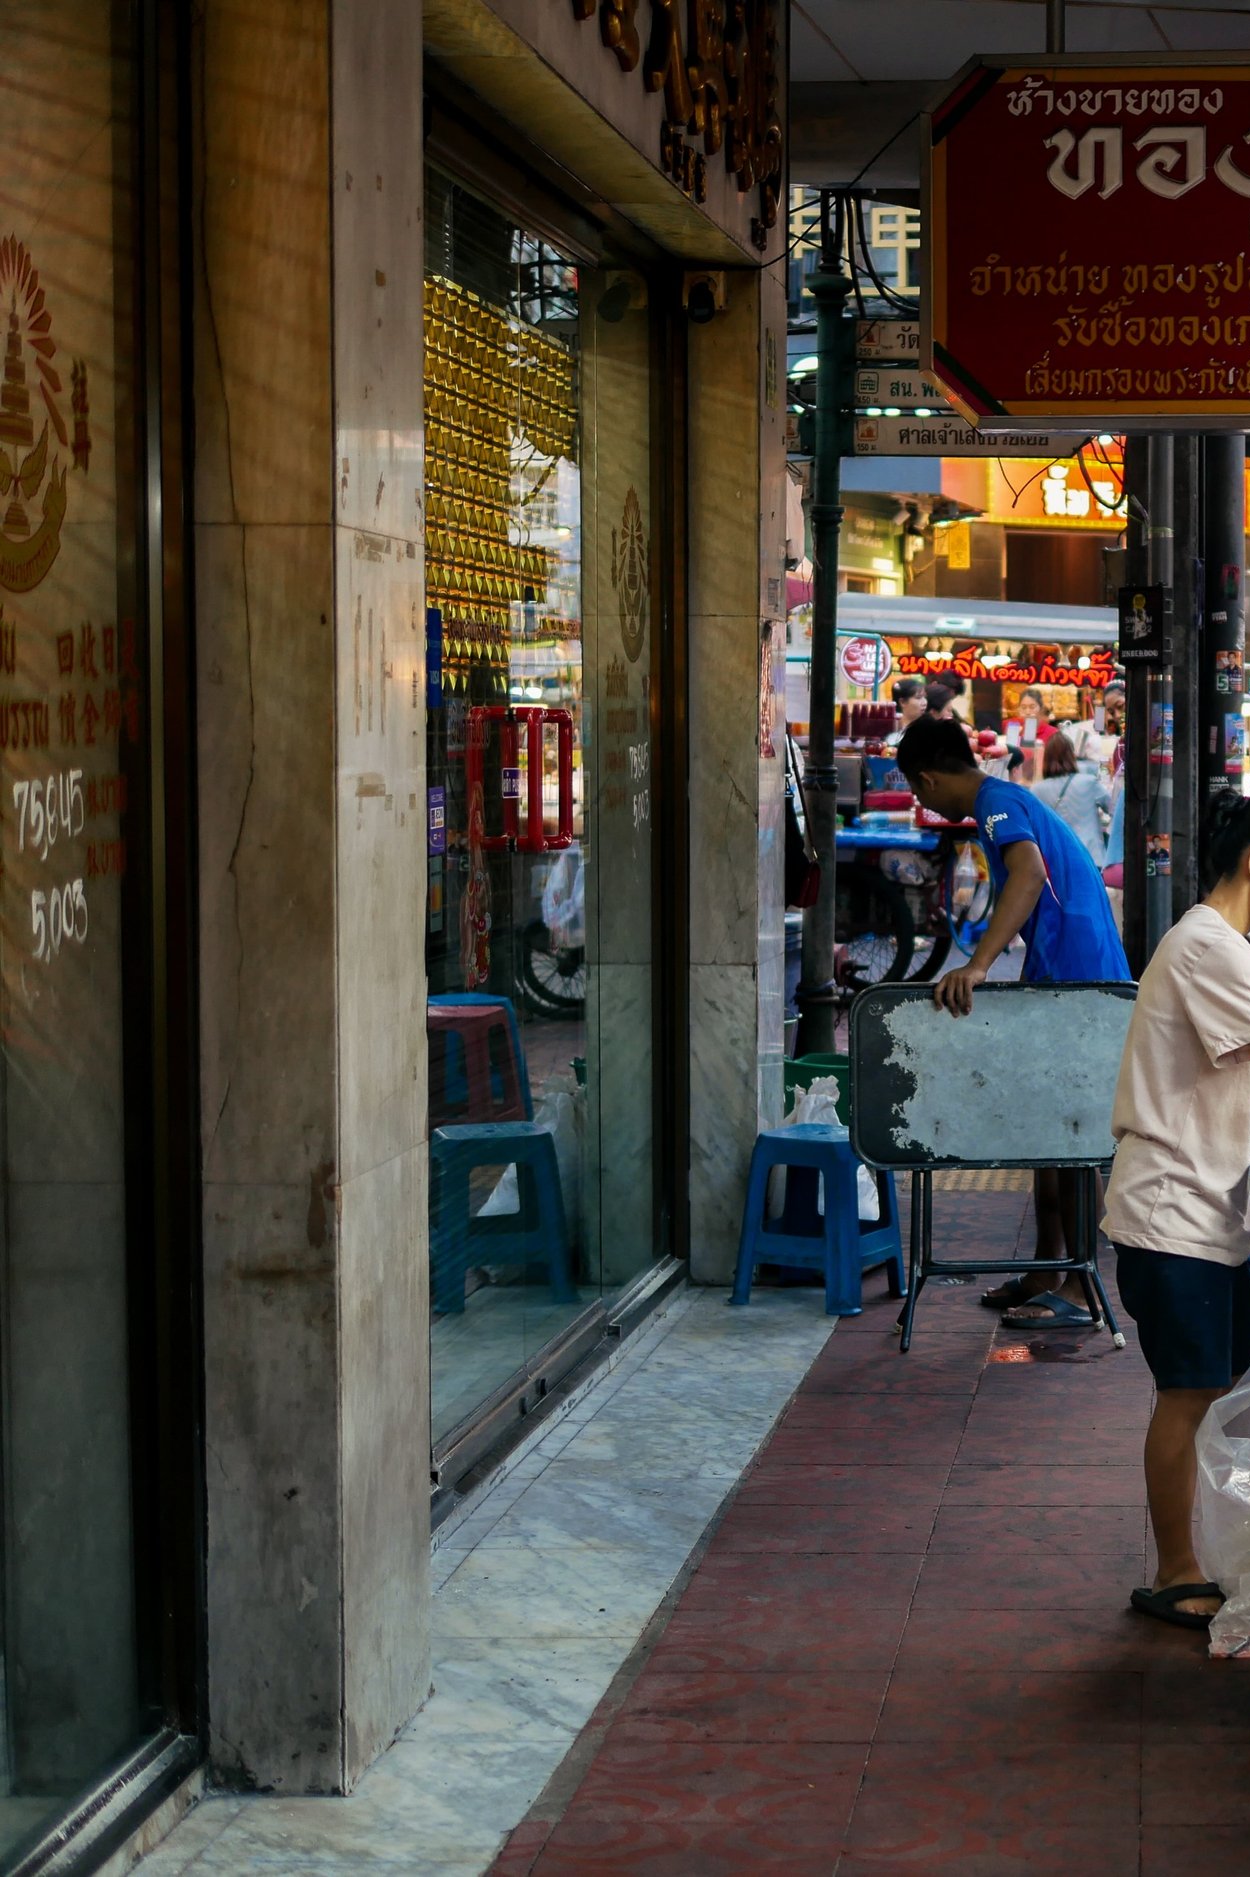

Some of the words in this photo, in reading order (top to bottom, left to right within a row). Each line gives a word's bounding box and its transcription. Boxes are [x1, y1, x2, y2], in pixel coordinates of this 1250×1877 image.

[1006, 75, 1224, 117] ห้างขายทอง
[969, 250, 1111, 297] จำหน่าย
[31, 878, 89, 965] 5,003
